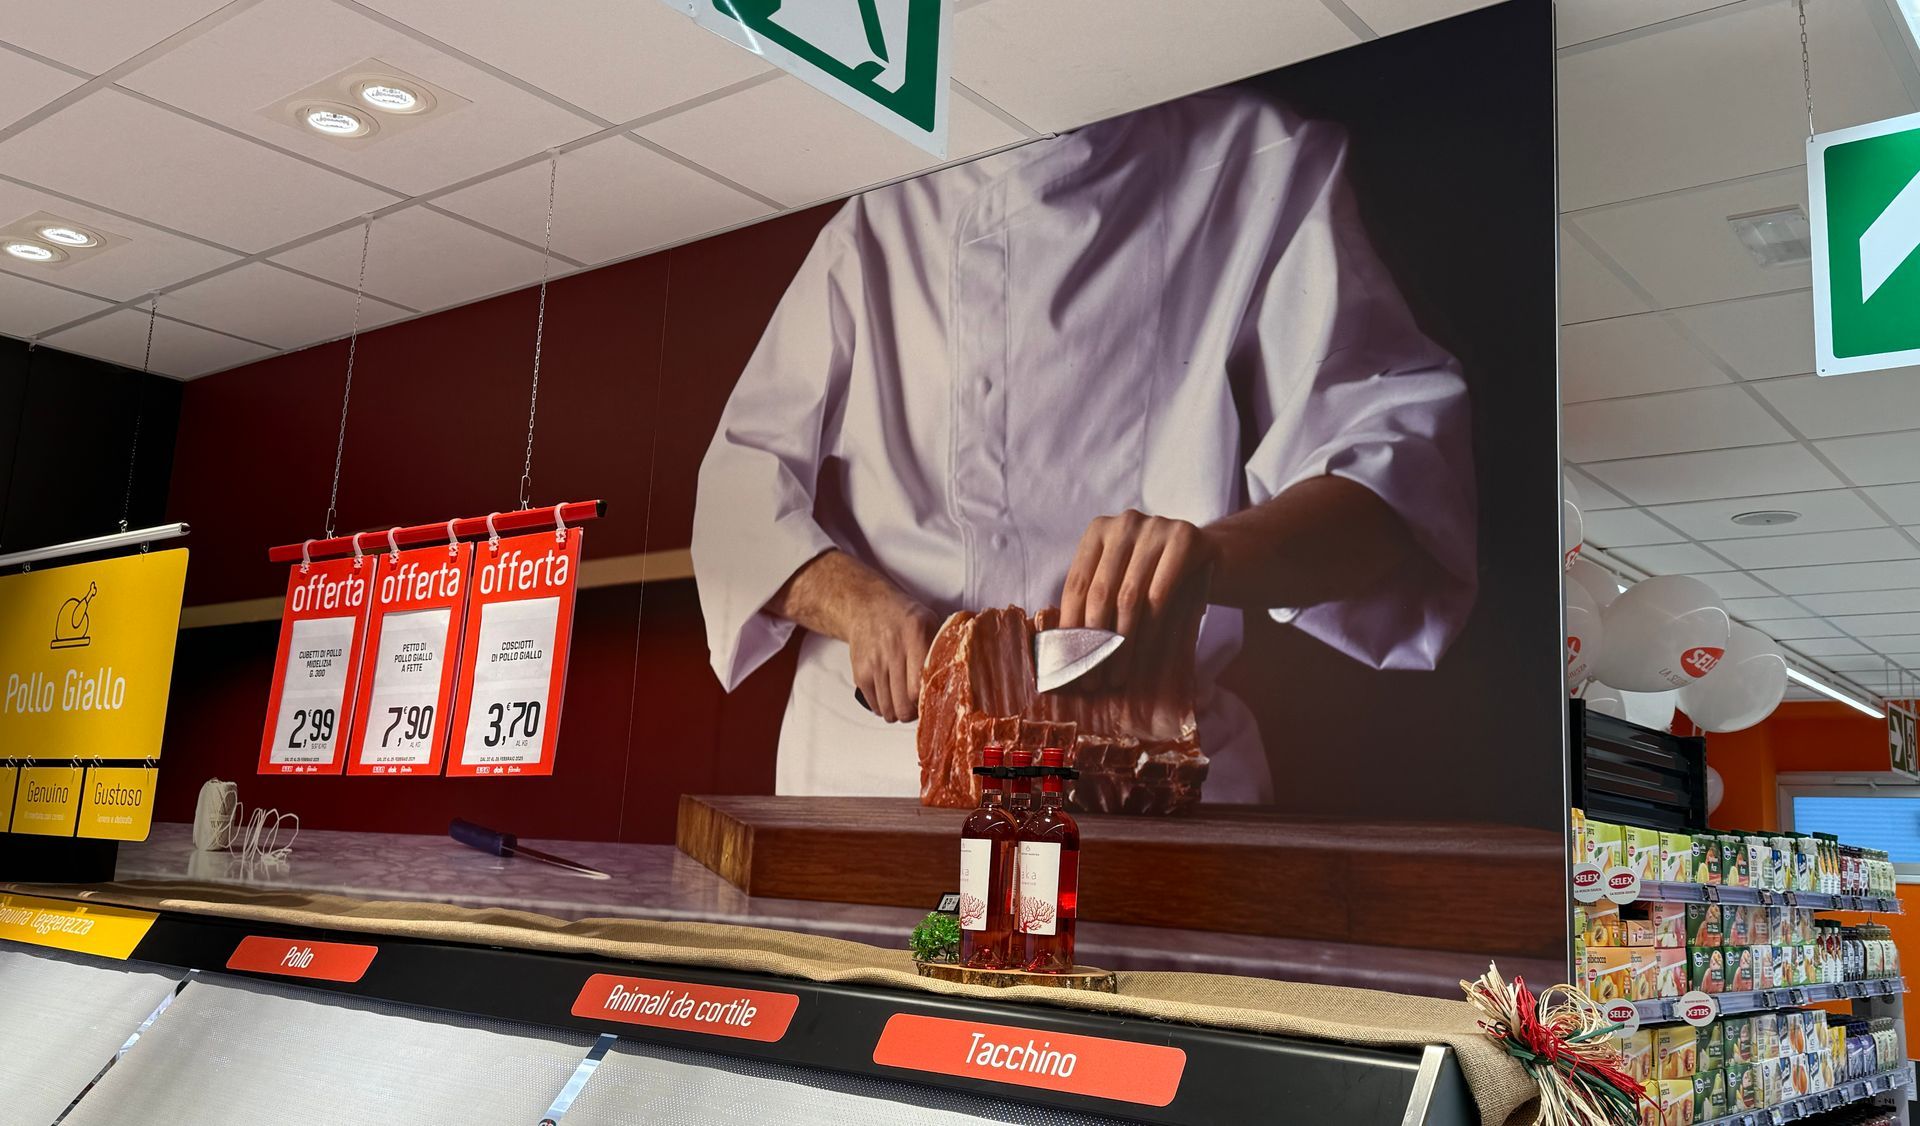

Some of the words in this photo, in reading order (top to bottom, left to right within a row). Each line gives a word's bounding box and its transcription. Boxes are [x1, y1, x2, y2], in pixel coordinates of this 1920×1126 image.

[480, 549, 569, 595] offerta
[381, 562, 460, 604] offerta
[292, 573, 364, 612] offerta
[299, 650, 320, 659] CUBETTI
[320, 649, 326, 658] DI
[326, 648, 343, 657] POLLO
[402, 643, 419, 652] PETTO
[420, 642, 427, 651] DI
[502, 640, 534, 651] COSCIOTTI
[394, 654, 412, 663] POLLO
[413, 652, 433, 661] GIALLO
[491, 653, 498, 662] DI
[499, 652, 518, 661] POLLO
[520, 650, 542, 660] GIALLO
[315, 669, 326, 677] 300
[401, 664, 406, 672] A
[407, 663, 423, 672] FETTE
[4, 671, 55, 713] Pollo
[62, 667, 126, 711] Giallo
[27, 781, 69, 804] Genuino
[94, 782, 142, 806] Gustoso
[1575, 873, 1600, 883] SELEX
[1610, 876, 1634, 886] SELEX
[31, 908, 95, 935] leggerezza
[280, 946, 315, 969] Pollo
[604, 984, 674, 1016] Animali
[668, 992, 696, 1019] da
[694, 999, 758, 1027] cortile
[1609, 1010, 1633, 1019] SELEX
[965, 1032, 1077, 1078] Tacchino
